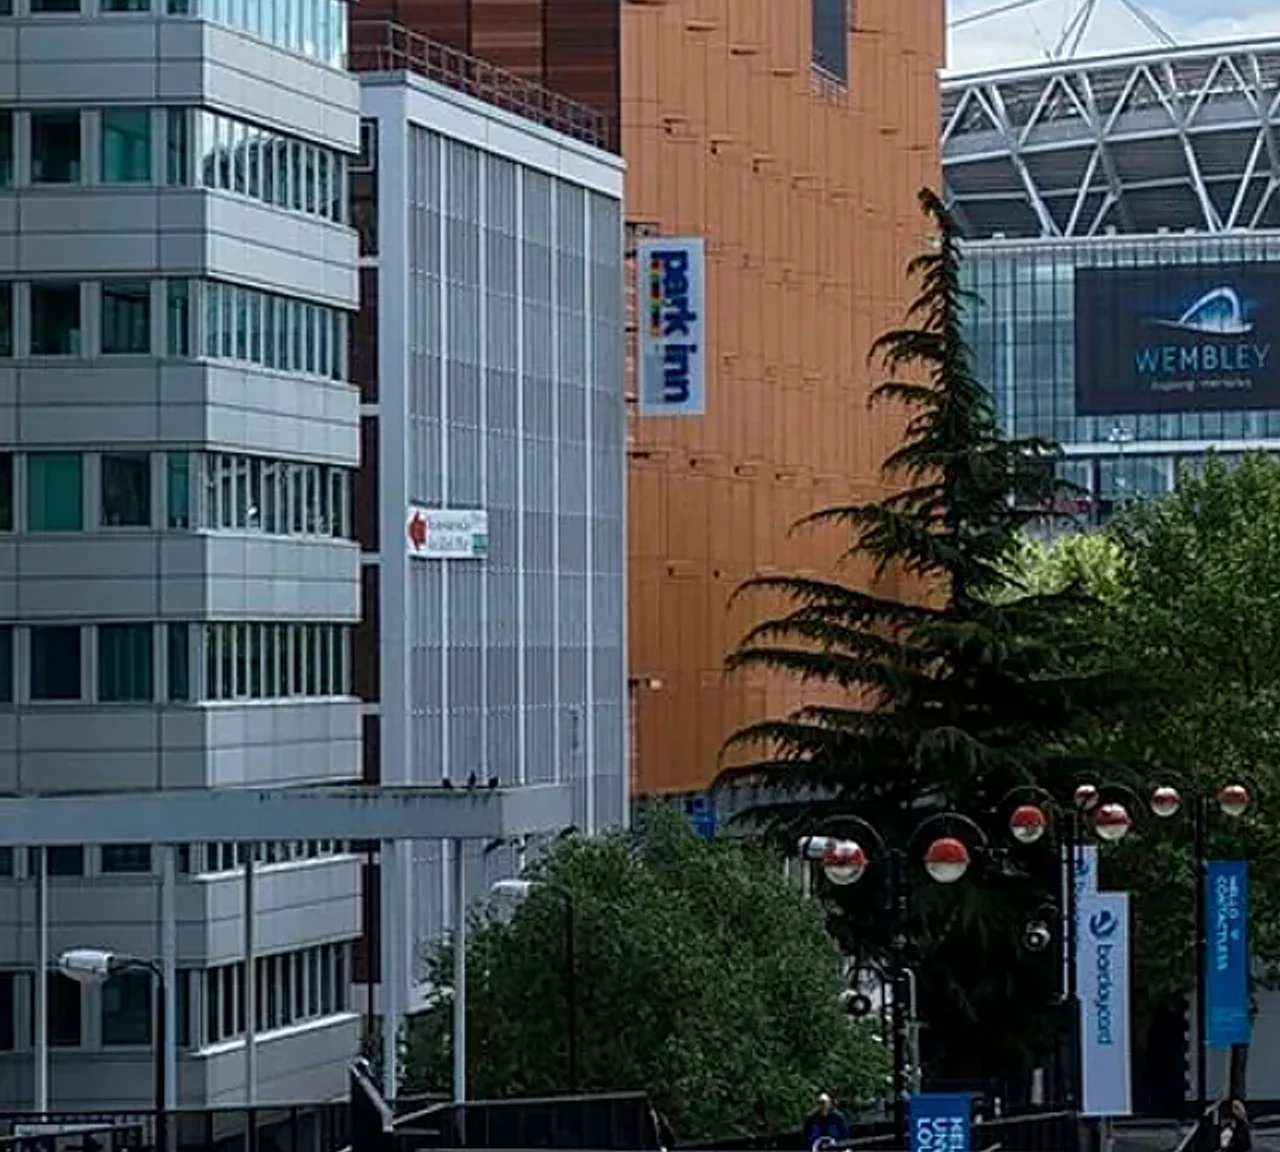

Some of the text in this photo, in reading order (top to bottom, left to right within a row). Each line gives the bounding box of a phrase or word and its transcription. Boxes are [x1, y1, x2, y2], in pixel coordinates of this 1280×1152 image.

[650, 249, 697, 337] park
[1135, 343, 1271, 374] WEMBLEY
[1095, 944, 1114, 1046] barclaycard
